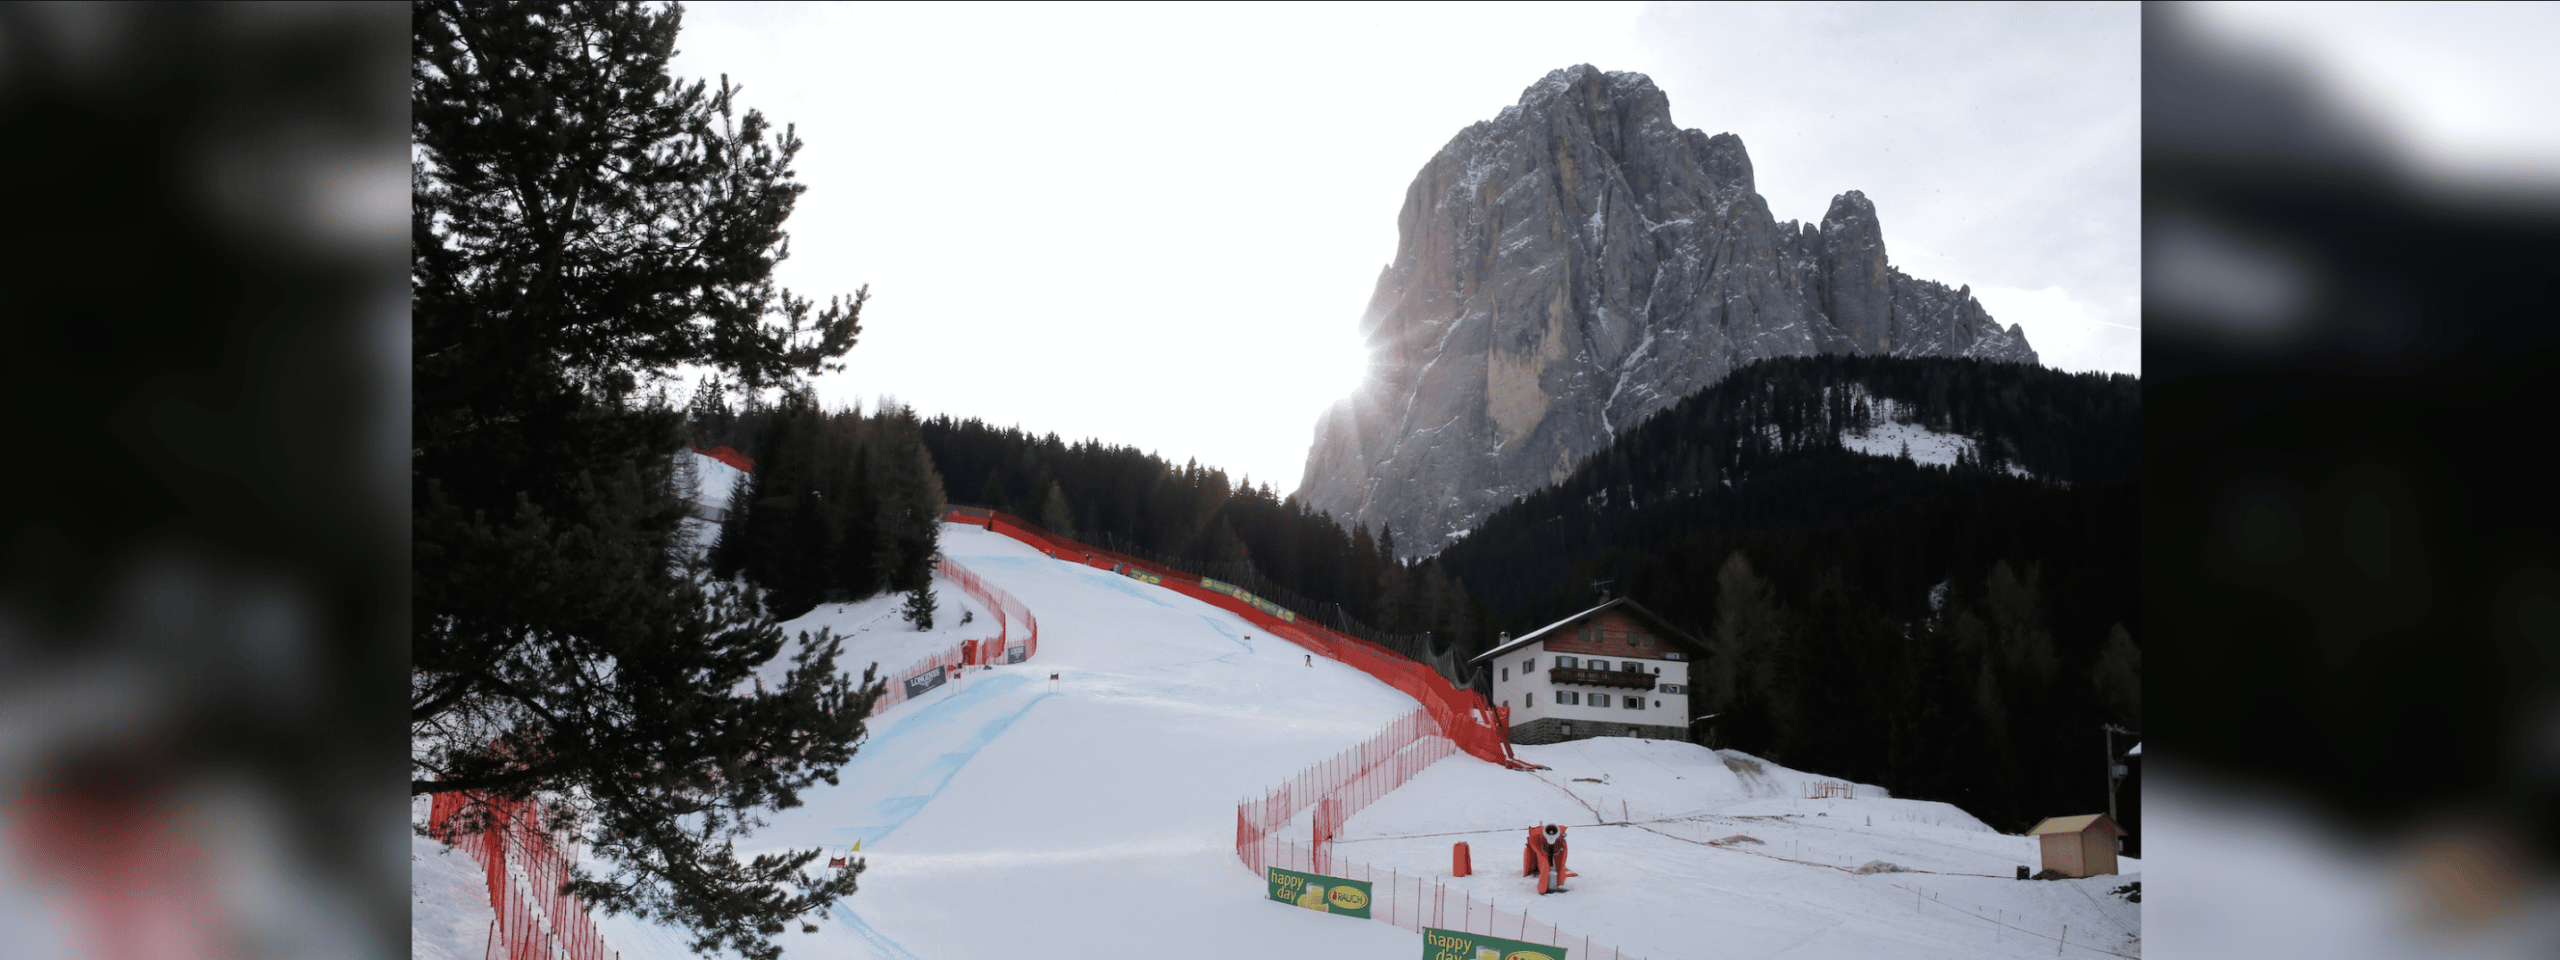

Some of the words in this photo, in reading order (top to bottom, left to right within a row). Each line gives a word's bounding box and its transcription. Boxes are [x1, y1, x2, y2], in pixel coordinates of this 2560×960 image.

[1271, 869, 1304, 891] happy
[1277, 886, 1297, 903] day
[1428, 930, 1473, 955] happy
